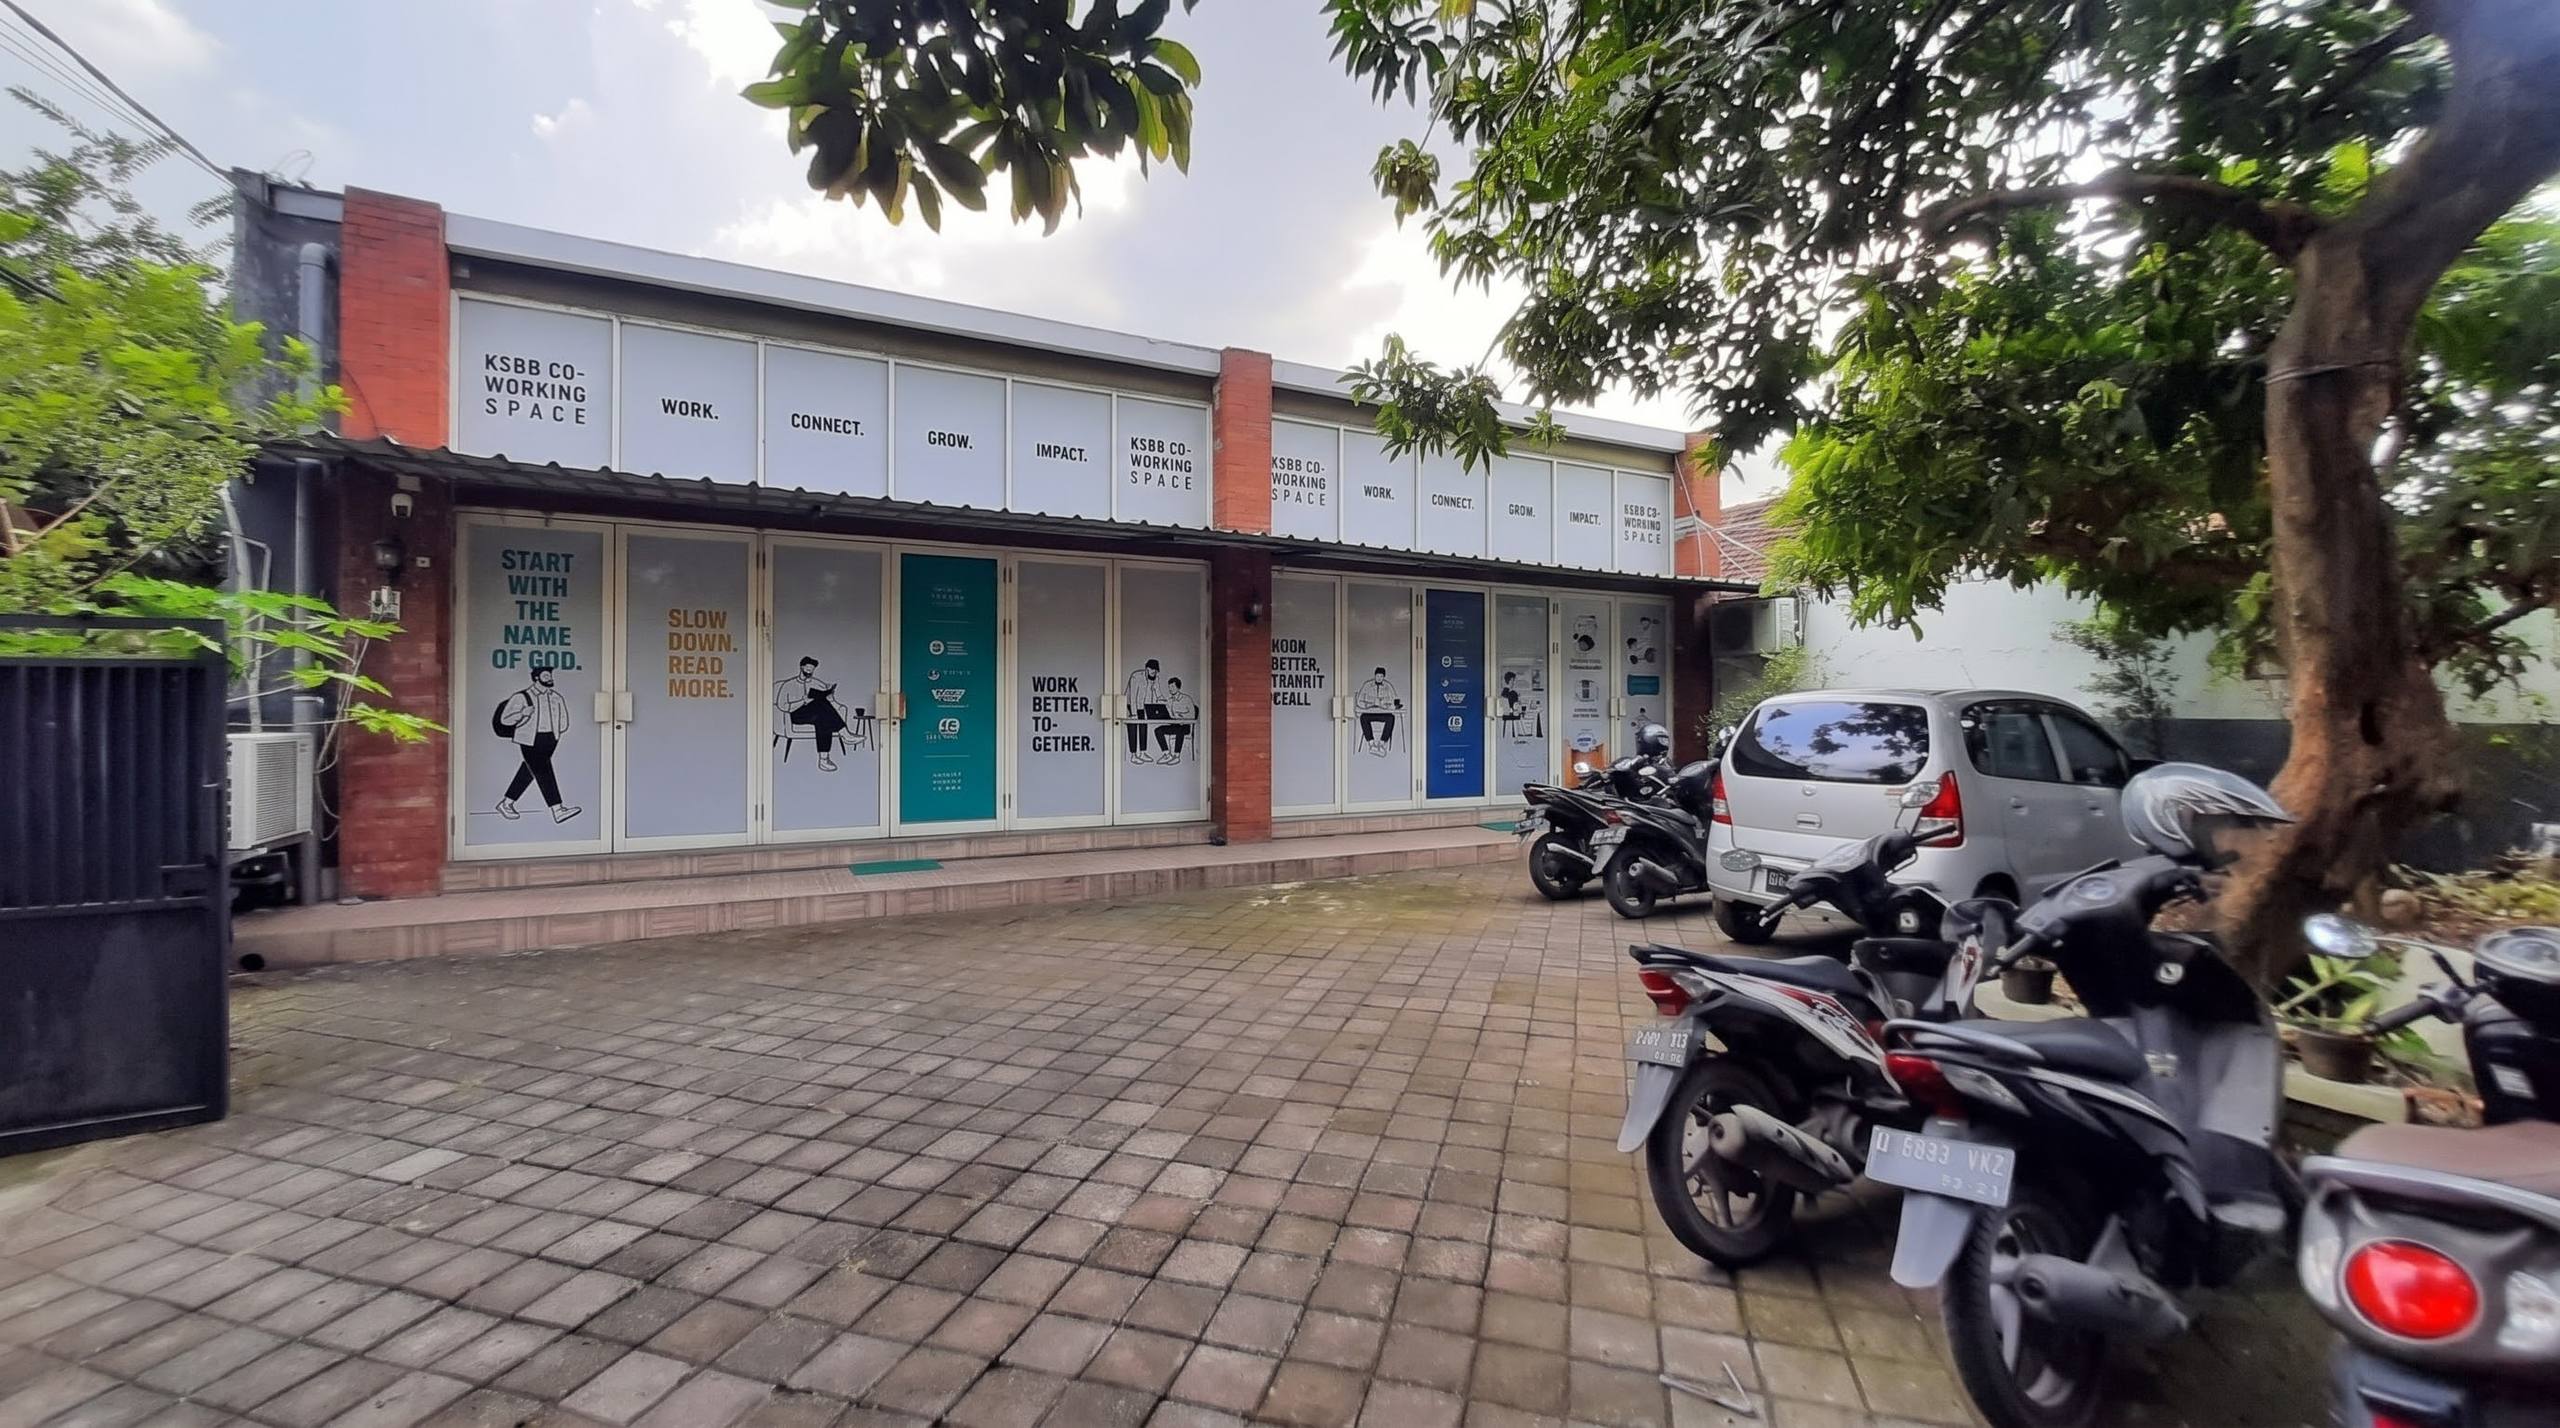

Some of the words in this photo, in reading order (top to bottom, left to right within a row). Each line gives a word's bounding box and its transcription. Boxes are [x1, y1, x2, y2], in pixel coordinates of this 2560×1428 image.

[485, 353, 541, 376] KSBB
[549, 362, 585, 380] CO-
[485, 375, 586, 403] WORKING
[485, 398, 586, 425] SPACE
[661, 398, 719, 420] WORK.
[791, 413, 864, 436] CONNECT.
[928, 430, 973, 450] GROW.
[1131, 436, 1165, 453] KSBB
[1170, 442, 1191, 456] CO-
[1036, 443, 1088, 462] IMPACT.
[1130, 453, 1192, 473] WORKING
[1272, 456, 1302, 472] KSBB
[1130, 470, 1192, 490] SPACE
[1272, 472, 1326, 490] WORKING
[1272, 488, 1326, 506] SPACE
[1363, 484, 1395, 500] WORK.
[1431, 493, 1474, 510] CONNECT.
[1569, 511, 1601, 526] IMPACT.
[501, 549, 574, 573] START
[508, 575, 568, 597] WITH
[515, 600, 560, 621] THE
[668, 608, 728, 630] SLOW
[504, 625, 571, 646] NAME
[668, 632, 738, 653] DOWN.
[492, 649, 522, 669] OF
[529, 650, 582, 670] GOD.
[668, 655, 723, 676] READ
[1271, 656, 1320, 673] BETTER,
[668, 678, 734, 698] MORE.
[1032, 676, 1078, 693] WORK
[1032, 697, 1093, 715] BETTER,
[1032, 716, 1058, 732] TO-
[1032, 736, 1095, 752] GETHER.
